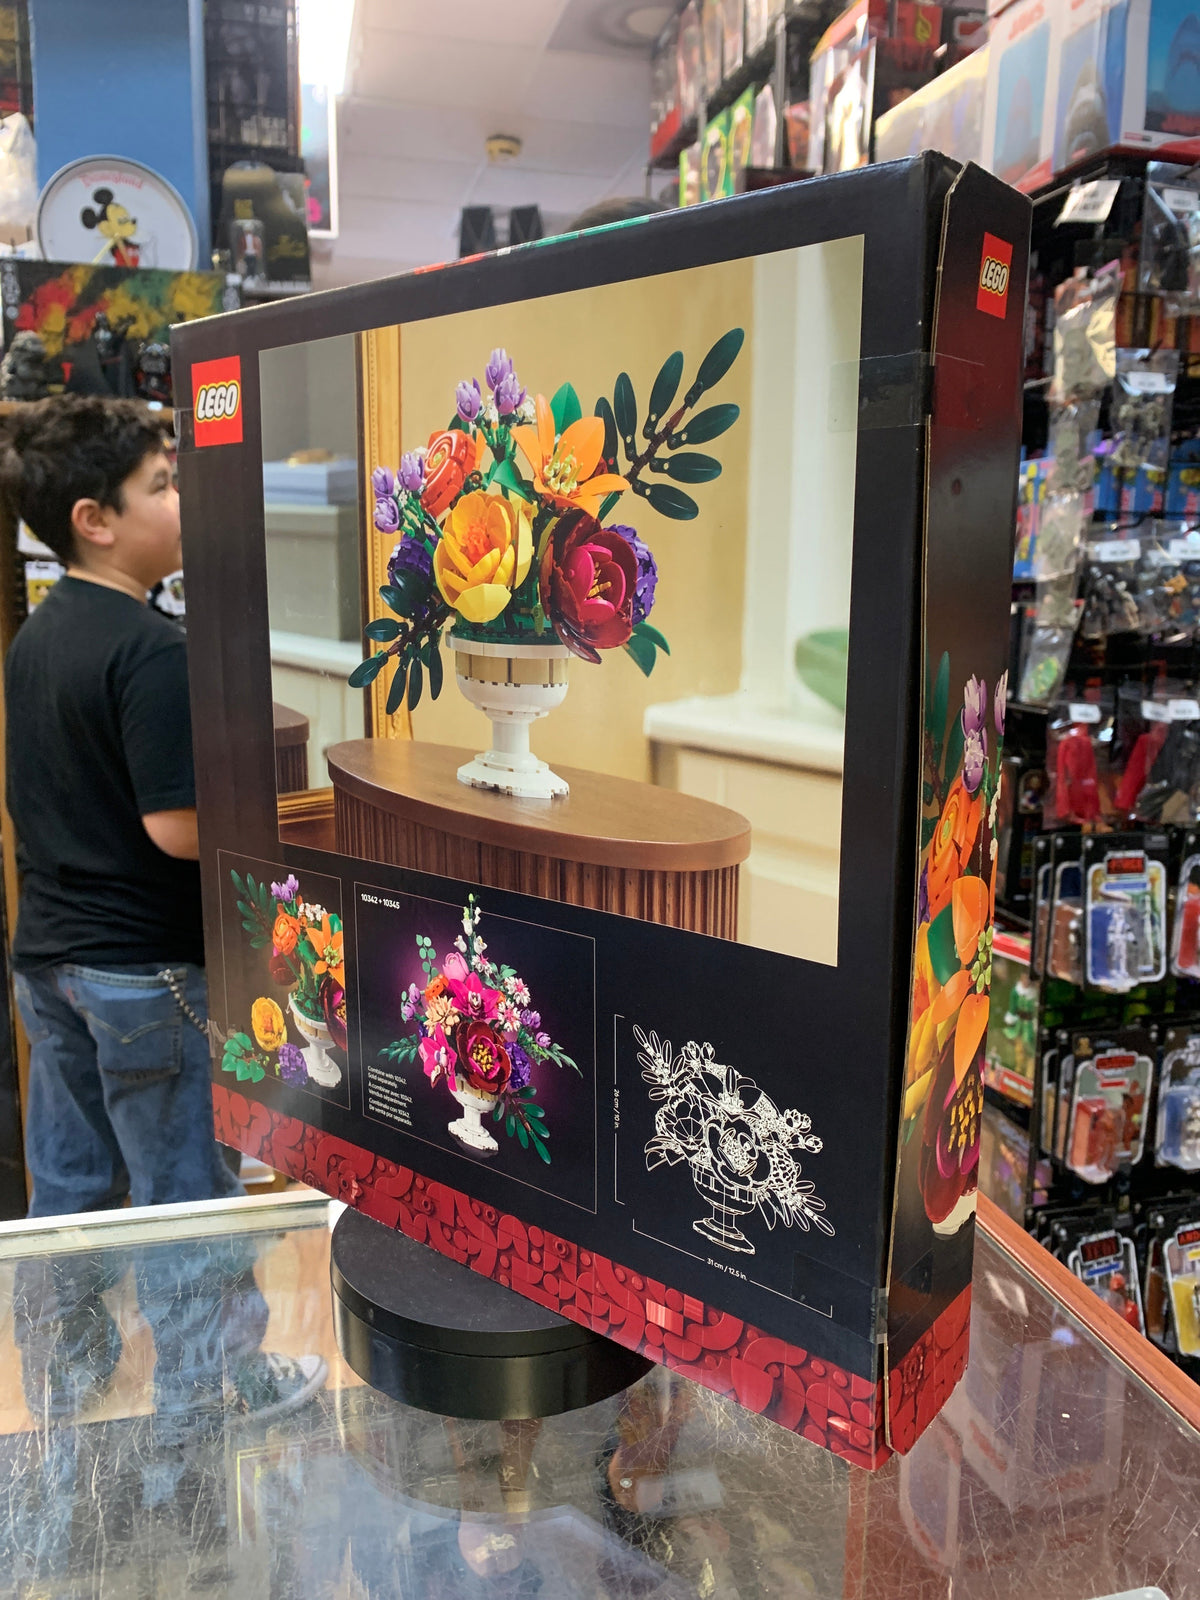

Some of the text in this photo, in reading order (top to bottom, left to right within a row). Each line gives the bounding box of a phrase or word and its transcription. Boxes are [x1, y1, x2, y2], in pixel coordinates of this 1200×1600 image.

[981, 257, 1009, 295] LEGO
[196, 381, 239, 422] LEGO
[361, 893, 378, 904] 10342
[383, 898, 400, 910] 10345
[613, 1088, 620, 1098] 26
[613, 1098, 619, 1108] cm
[707, 1257, 714, 1266] 31
[714, 1262, 724, 1270] cm
[728, 1267, 740, 1277] 12.5
